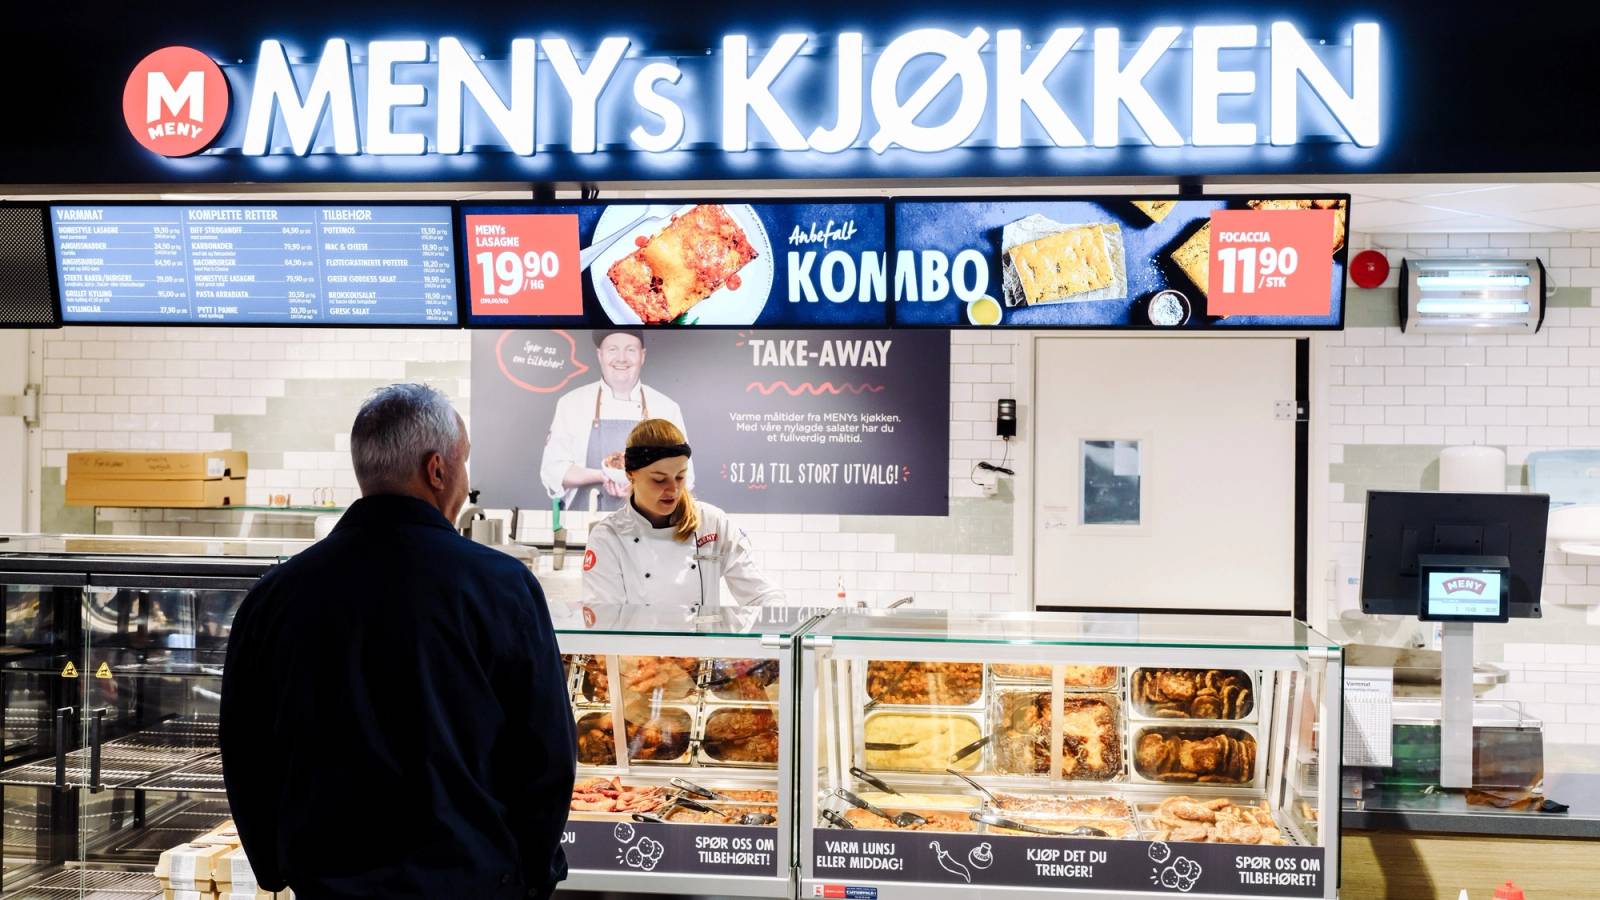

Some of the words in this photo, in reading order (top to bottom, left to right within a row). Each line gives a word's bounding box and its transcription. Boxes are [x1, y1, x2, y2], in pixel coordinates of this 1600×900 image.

[242, 38, 684, 156] MENYs
[723, 22, 1380, 155] KJØKKEN
[147, 121, 203, 141] MENY
[57, 209, 104, 220] VARMMAT
[189, 209, 242, 220] KOMPLETTE
[245, 209, 279, 220] RETTER
[323, 209, 373, 221] TILBEHØR
[475, 225, 506, 235] MENYs
[789, 220, 858, 248] Anbefalt
[1219, 232, 1271, 242] FOCACCIA
[476, 237, 520, 247] LASAGNE
[788, 249, 989, 303] KOMBO
[513, 355, 526, 364] om
[748, 340, 893, 366] TAKE-AWAY
[730, 412, 761, 422] Varme
[764, 411, 805, 422] måltider
[807, 412, 821, 422] fra
[823, 413, 858, 422] MENYs
[861, 413, 902, 425] kjøkken.
[736, 423, 758, 431] Med
[760, 423, 781, 432] våre
[784, 423, 824, 434] nylagde
[825, 424, 859, 432] salater
[862, 424, 878, 432] har
[881, 424, 894, 432] du
[767, 435, 778, 443] et
[780, 433, 826, 444] fullverdig
[828, 433, 863, 443] måltid.
[730, 463, 745, 483] SI
[749, 463, 765, 483] JA
[769, 463, 793, 484] TIL
[798, 463, 840, 484] STORT
[844, 464, 899, 485] UTVALG!
[1447, 579, 1483, 591] MENY
[695, 836, 728, 849] SPØR
[732, 838, 752, 850] OSS
[756, 838, 775, 851] OM
[825, 841, 859, 854] VARM
[862, 842, 896, 855] LUNSJ
[698, 851, 771, 866] TILBEHØRET!
[816, 855, 847, 869] ELLER
[849, 856, 904, 871] MIDDAG!
[1026, 848, 1060, 862] KJØP
[1064, 849, 1086, 862] DET
[1089, 849, 1107, 863] DU
[1034, 863, 1094, 878] TRENGER!
[1235, 856, 1272, 870] SPØR
[1275, 857, 1297, 870] OSS
[1300, 858, 1321, 871] OM
[1239, 871, 1316, 886] TILBEHØRET!
